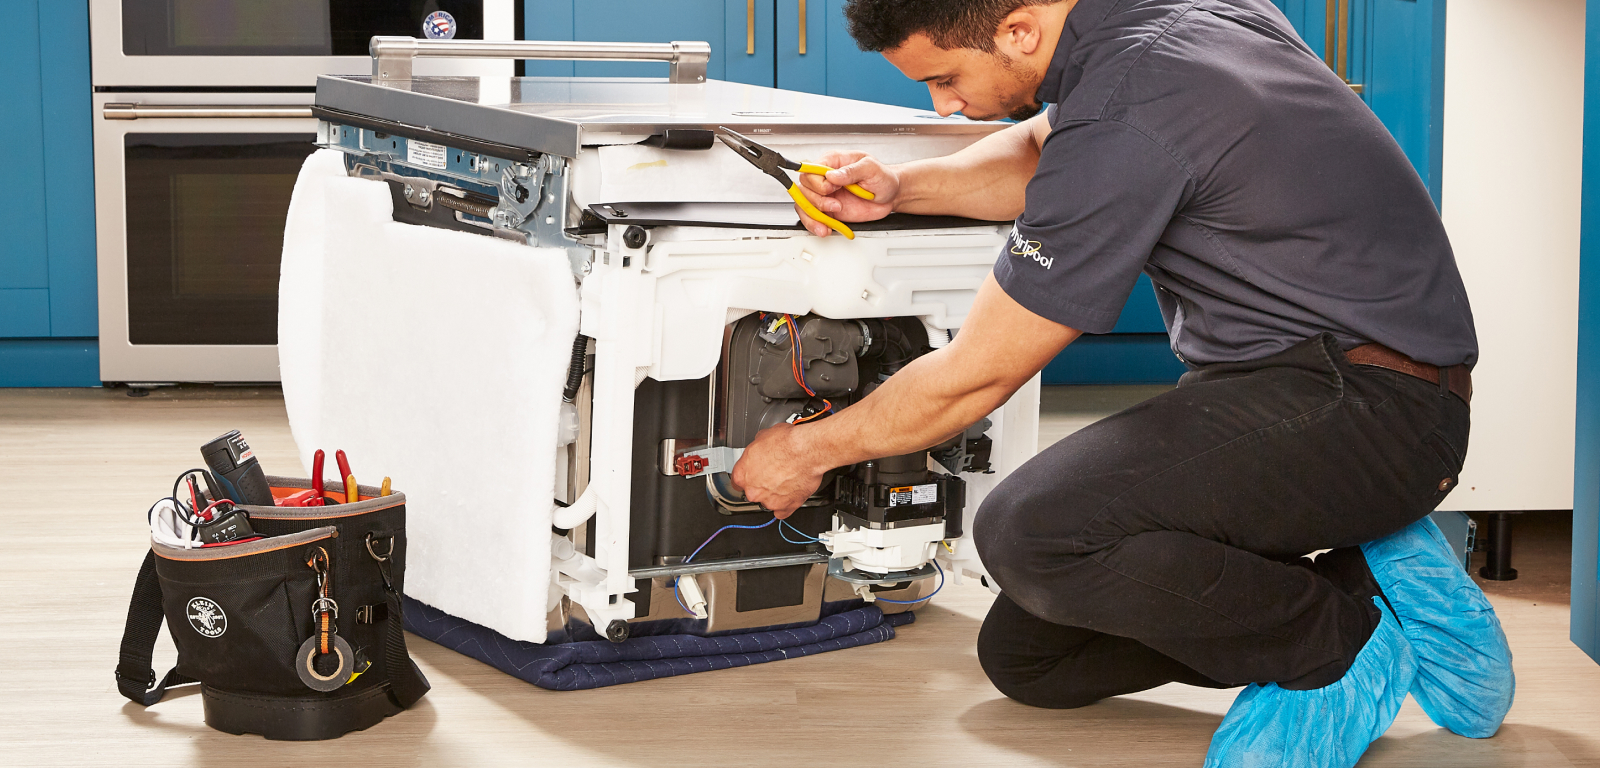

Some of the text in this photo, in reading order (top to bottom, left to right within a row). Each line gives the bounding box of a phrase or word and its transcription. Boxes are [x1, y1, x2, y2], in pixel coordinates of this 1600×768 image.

[426, 12, 453, 26] AMERICA
[191, 600, 215, 609] KLEIN
[200, 626, 222, 636] TOOLS
